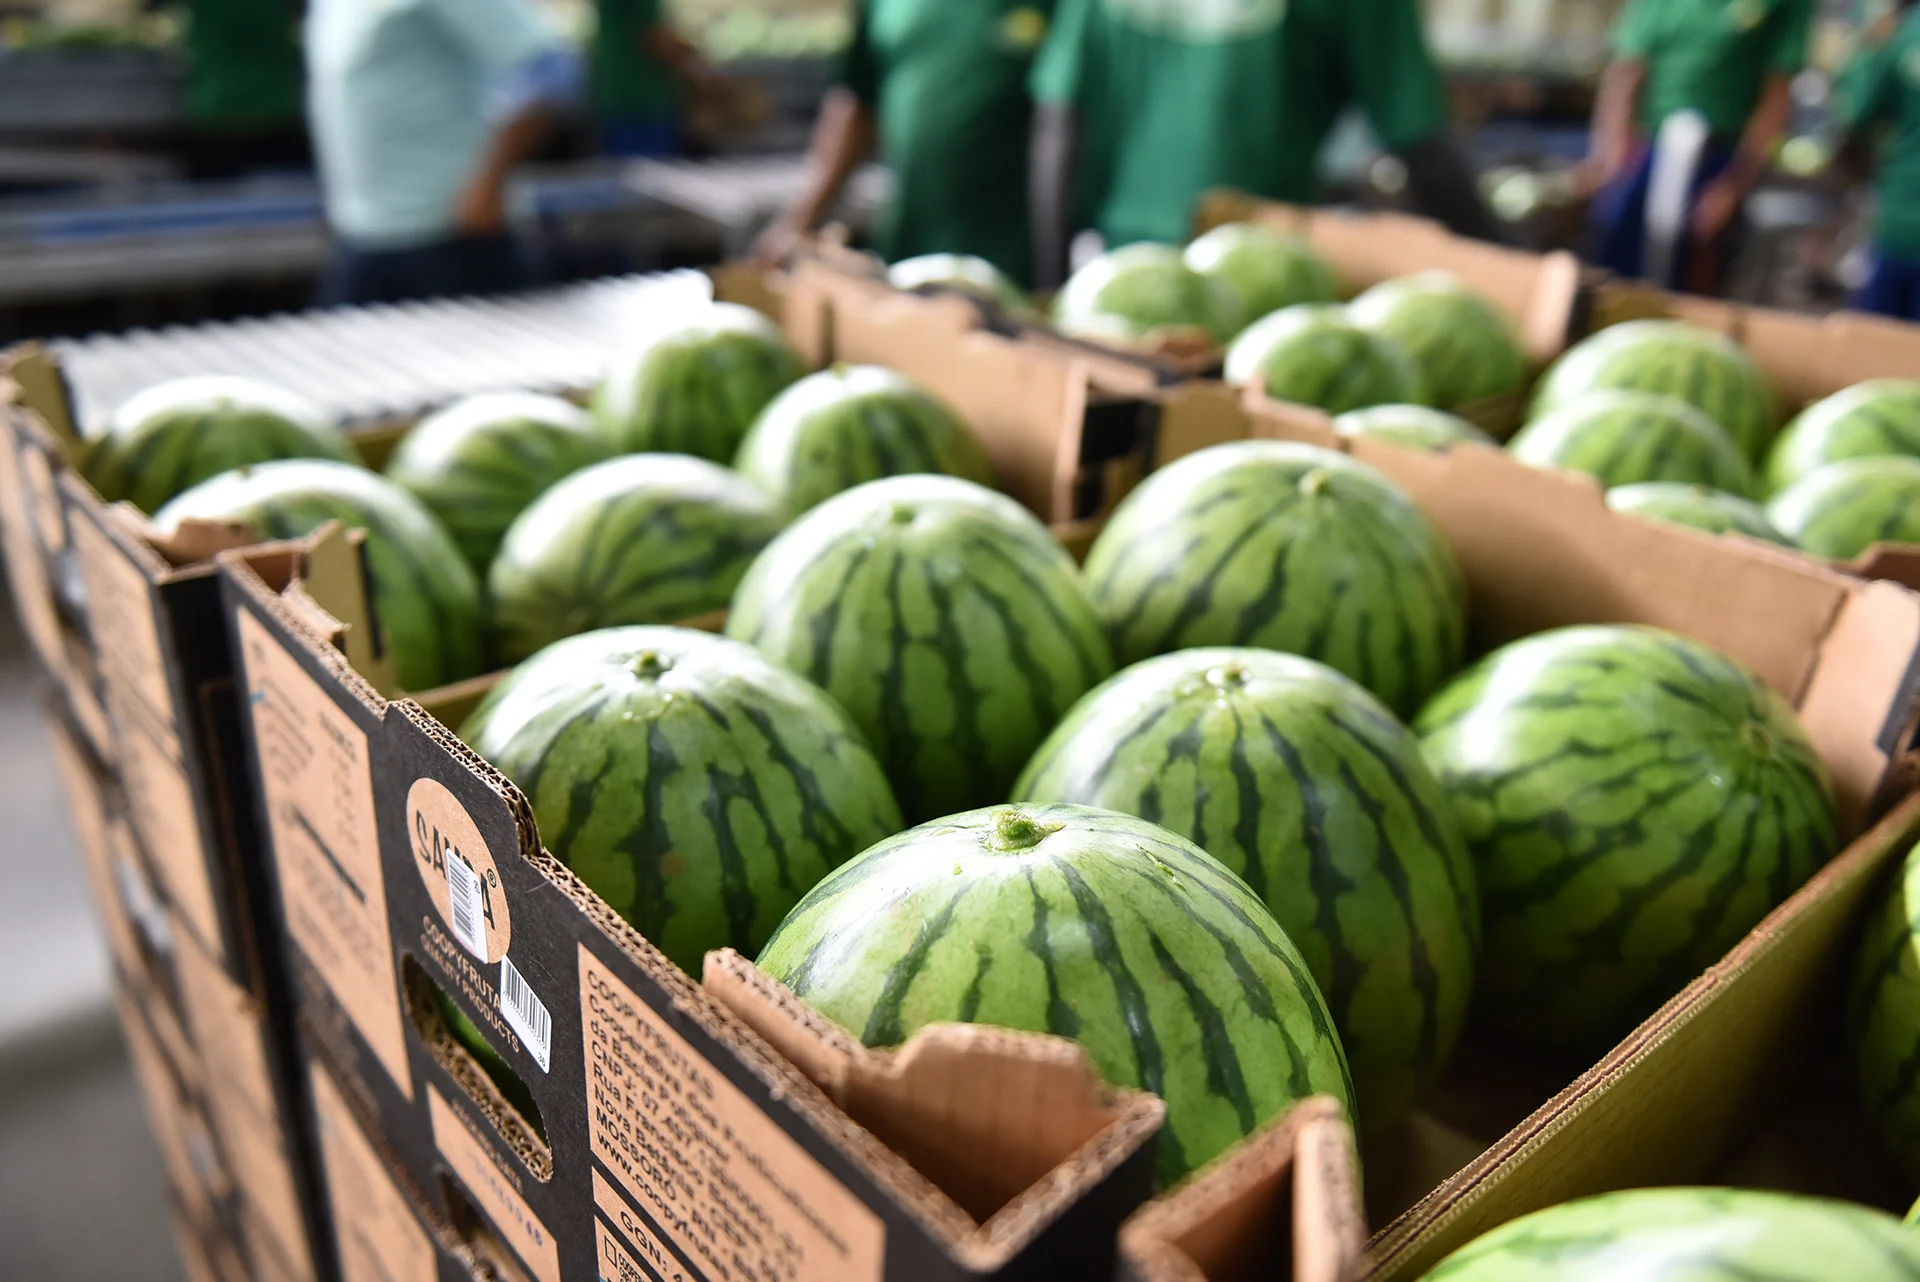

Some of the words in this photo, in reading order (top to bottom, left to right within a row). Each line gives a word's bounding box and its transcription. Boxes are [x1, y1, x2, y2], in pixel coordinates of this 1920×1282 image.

[416, 809, 496, 931] SAA
[423, 915, 502, 1010] COOPYFRUTA
[462, 979, 520, 1053] PRODUCTS
[590, 1019, 608, 1045] da
[592, 1060, 621, 1103] Rua
[594, 1083, 631, 1133] Nova
[595, 1104, 676, 1202] MOSSORÓ
[620, 1210, 668, 1272] GGN:
